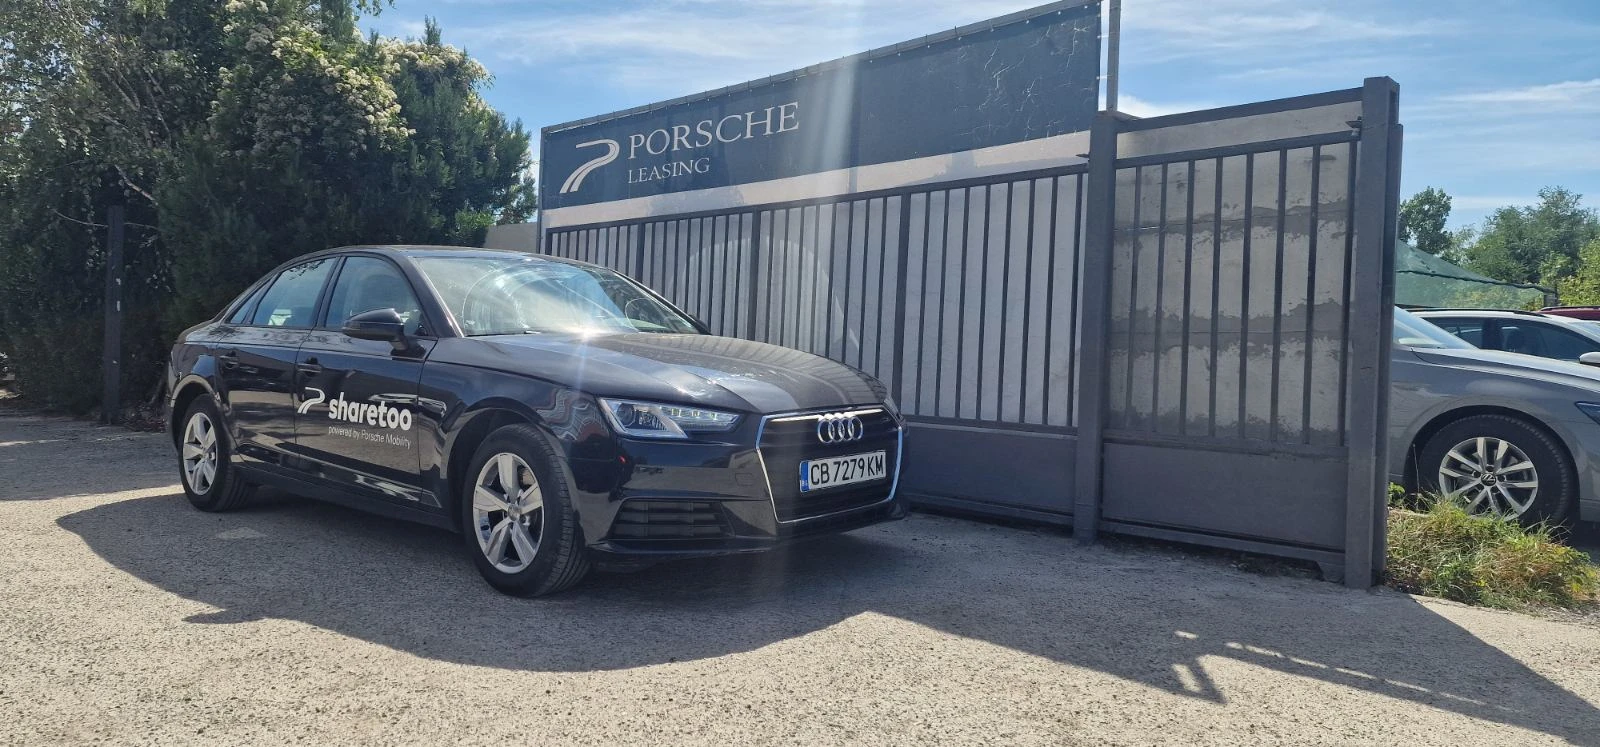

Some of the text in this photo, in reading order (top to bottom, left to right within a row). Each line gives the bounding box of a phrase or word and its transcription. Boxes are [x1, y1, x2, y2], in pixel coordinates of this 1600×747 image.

[627, 101, 799, 160] PORSCHE
[628, 157, 710, 184] LEASING
[328, 391, 412, 431] sharetoo
[328, 426, 411, 450] powered by Porsche Mobility
